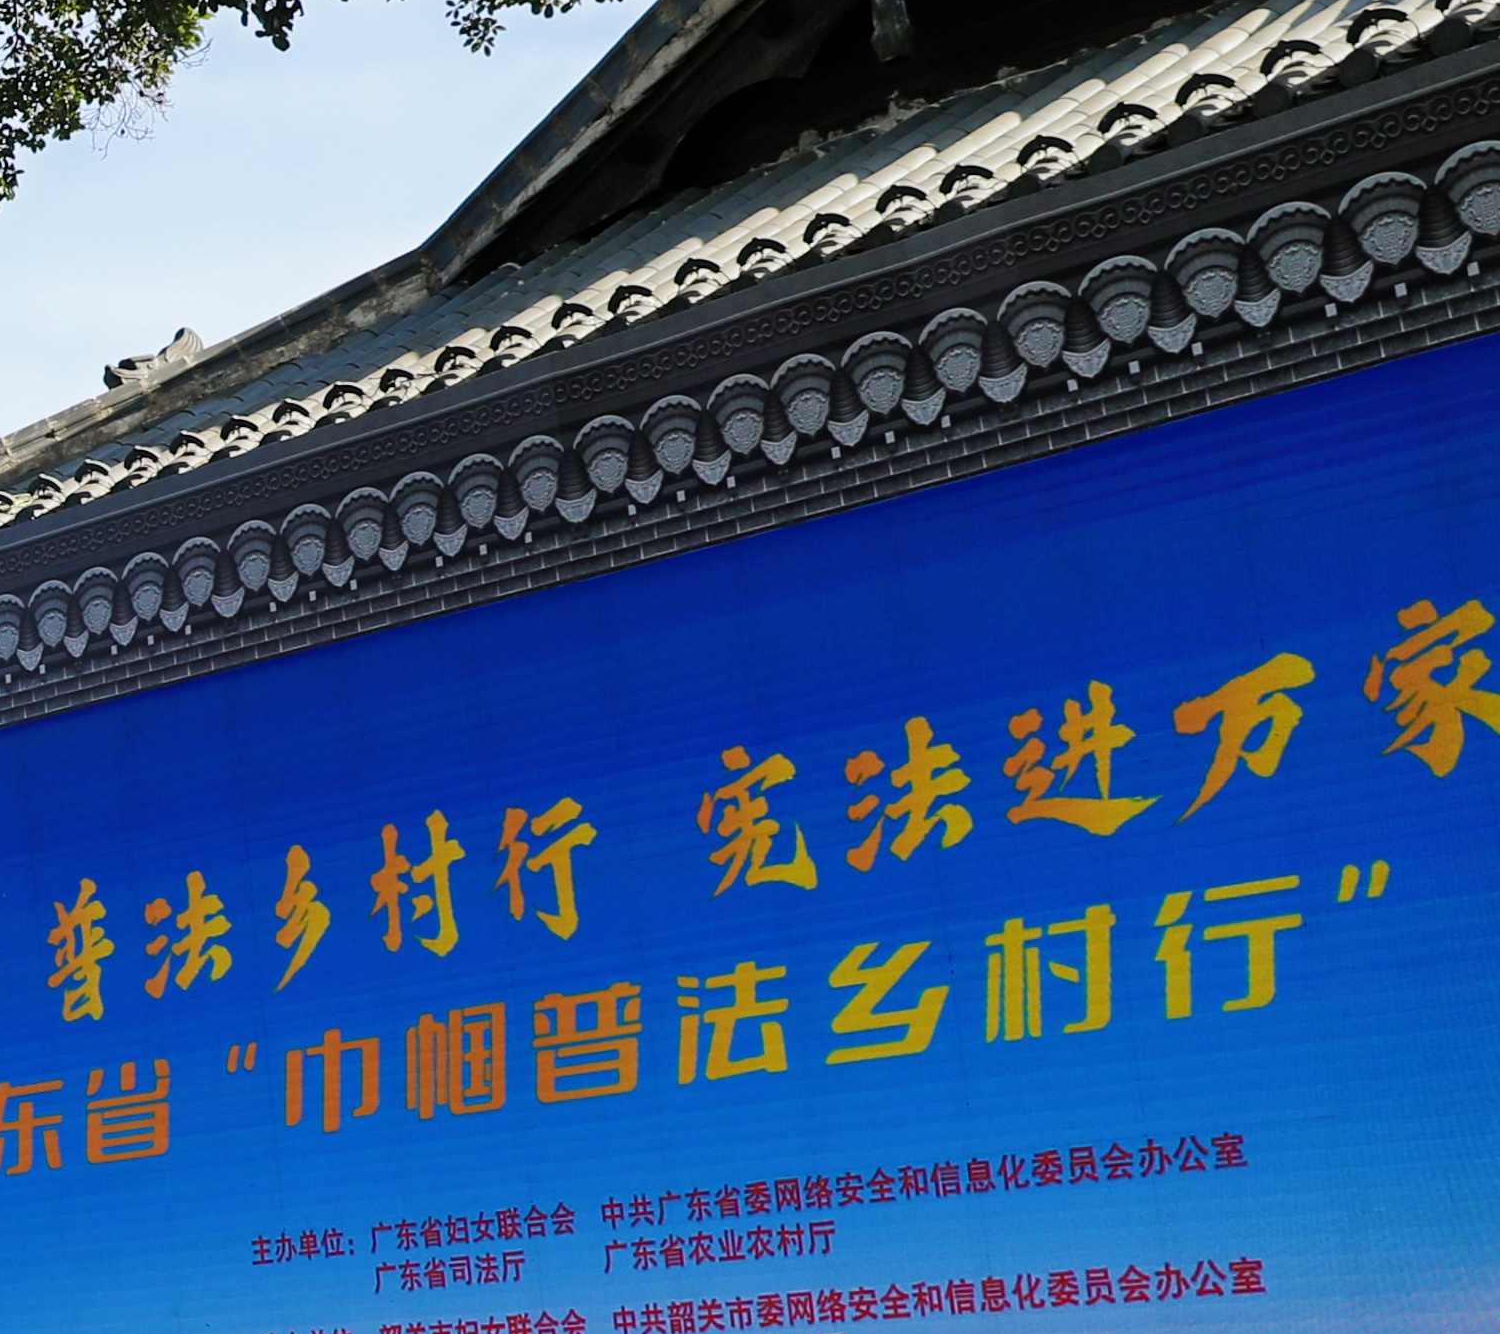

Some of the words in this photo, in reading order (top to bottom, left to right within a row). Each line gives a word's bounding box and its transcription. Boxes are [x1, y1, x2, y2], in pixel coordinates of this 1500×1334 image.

[46, 796, 599, 1023] 普法乡村行
[697, 598, 1500, 900] 宪法进万家
[600, 1131, 1249, 1230] 中共广东省委网络安全和信息化委员会办公室
[373, 1249, 527, 1294] 广东省司法厅
[603, 1219, 837, 1274] 广东省农业农村厅
